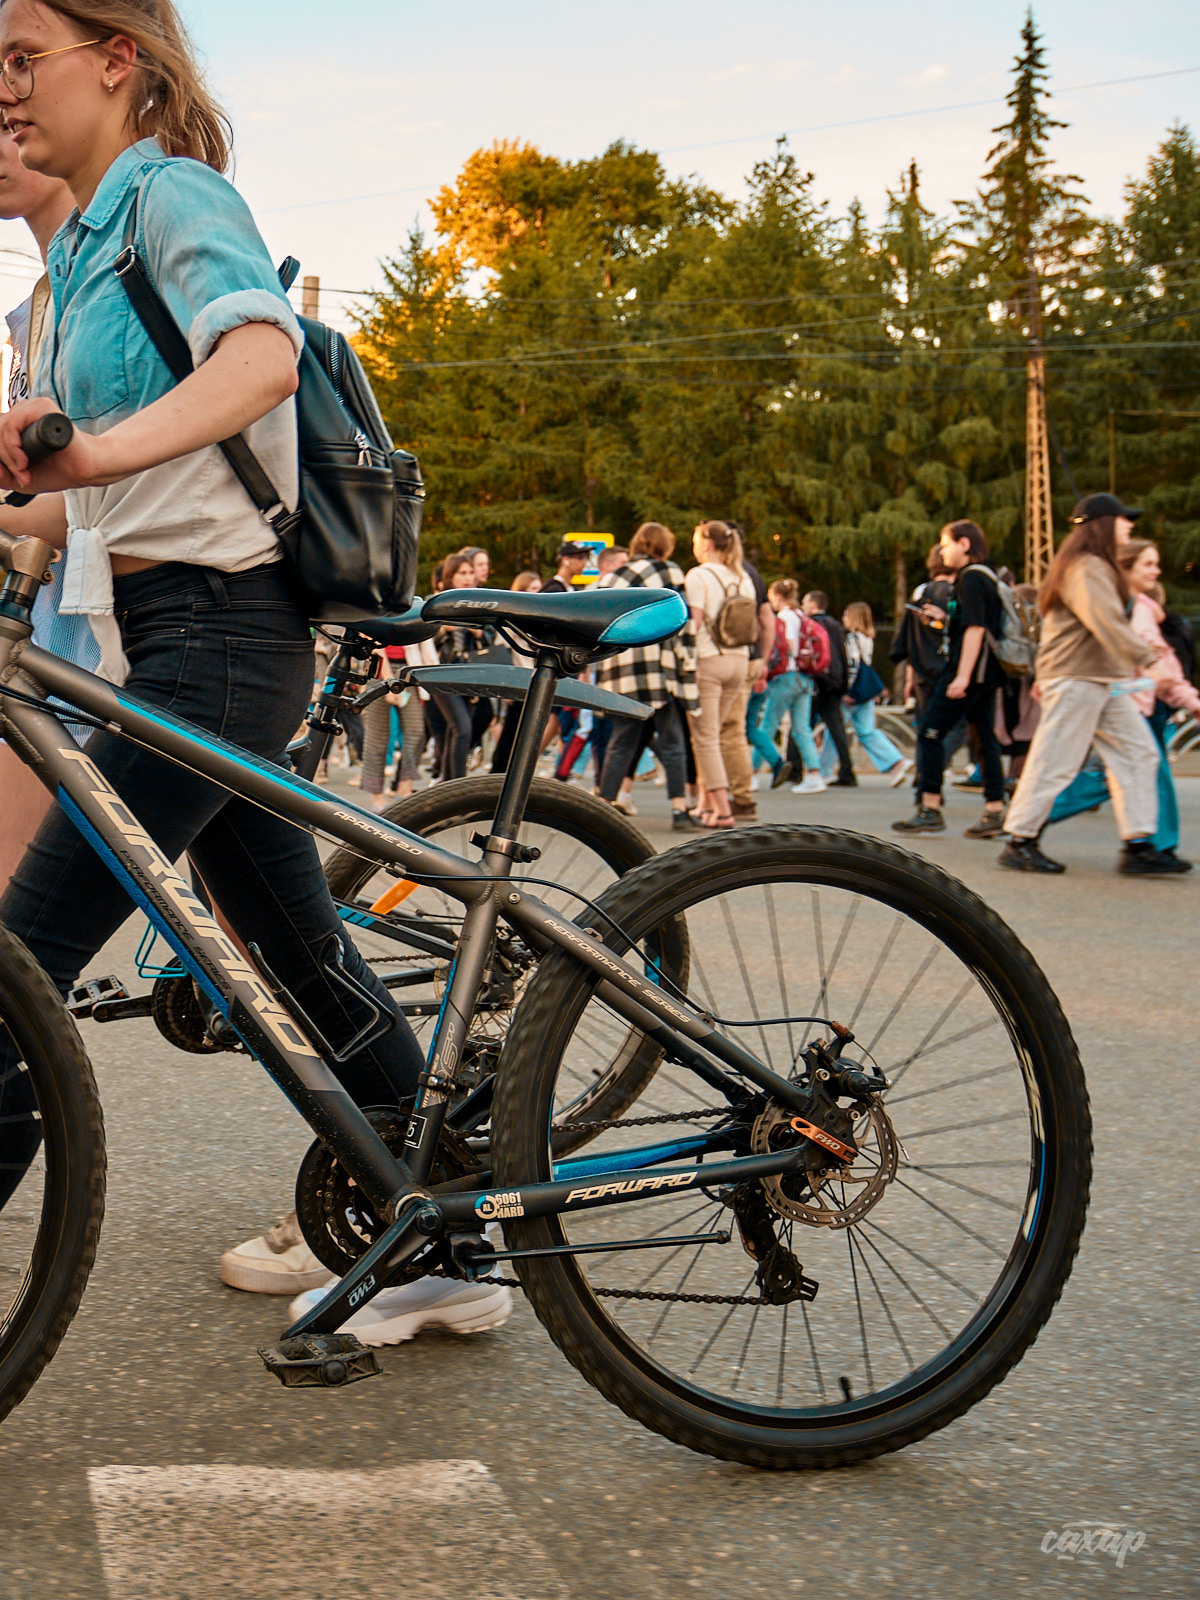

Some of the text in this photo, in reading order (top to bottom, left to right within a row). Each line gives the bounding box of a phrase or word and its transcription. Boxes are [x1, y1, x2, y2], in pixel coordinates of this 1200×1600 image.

[333, 811, 424, 856] APACHE 2.0
[57, 748, 321, 1059] FORWARD
[120, 850, 232, 990] PERFORMANCE SERIES
[544, 919, 692, 1023] PERFORMANCE SERIES
[814, 1133, 841, 1150] FWD
[495, 1191, 522, 1205] 6061
[565, 1171, 698, 1204] FORWARD
[497, 1205, 525, 1219] HARD
[348, 1274, 376, 1307] FWD
